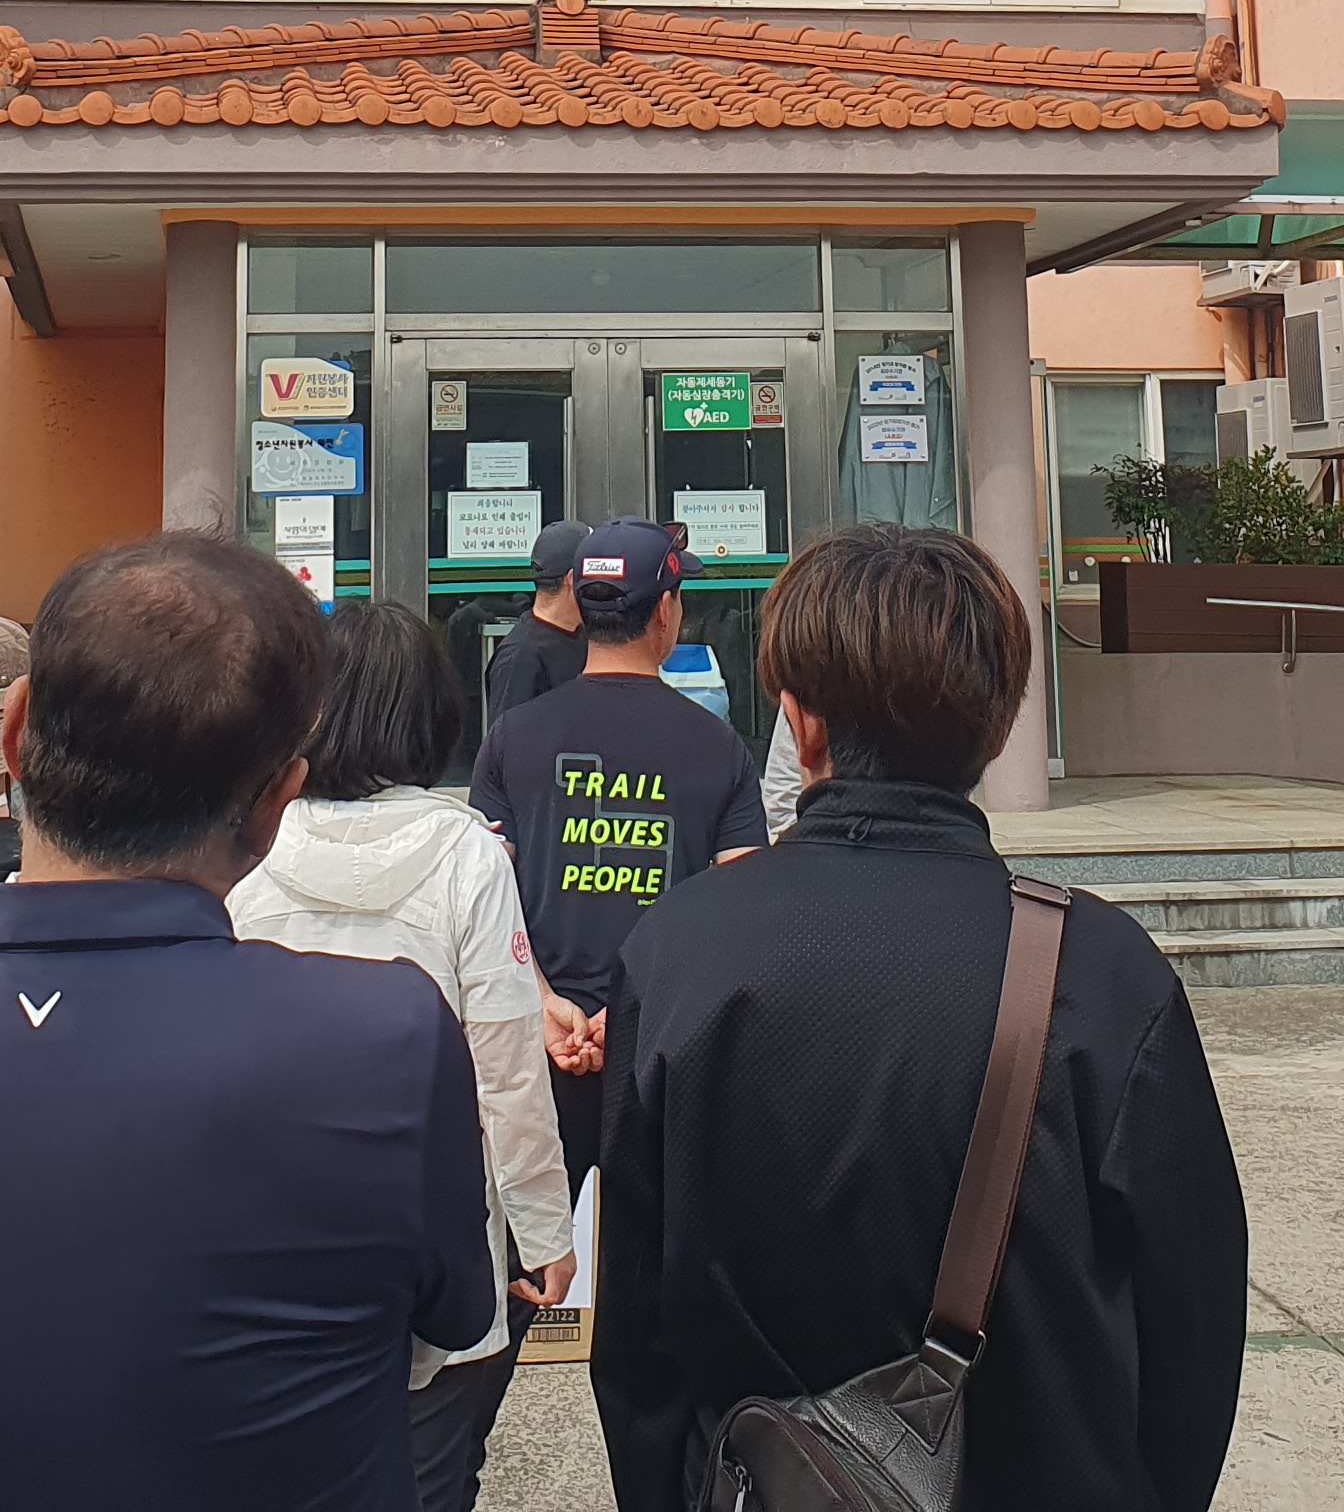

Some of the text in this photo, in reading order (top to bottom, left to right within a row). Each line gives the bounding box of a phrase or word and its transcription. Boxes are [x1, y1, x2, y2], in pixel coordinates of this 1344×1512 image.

[676, 377, 735, 388] 자동제세동기
[668, 389, 745, 401] (자동심장충격기)
[703, 411, 730, 423] AED
[565, 771, 666, 800] TRAIL
[562, 818, 665, 846] MOVES
[561, 865, 663, 894] PEOPLE
